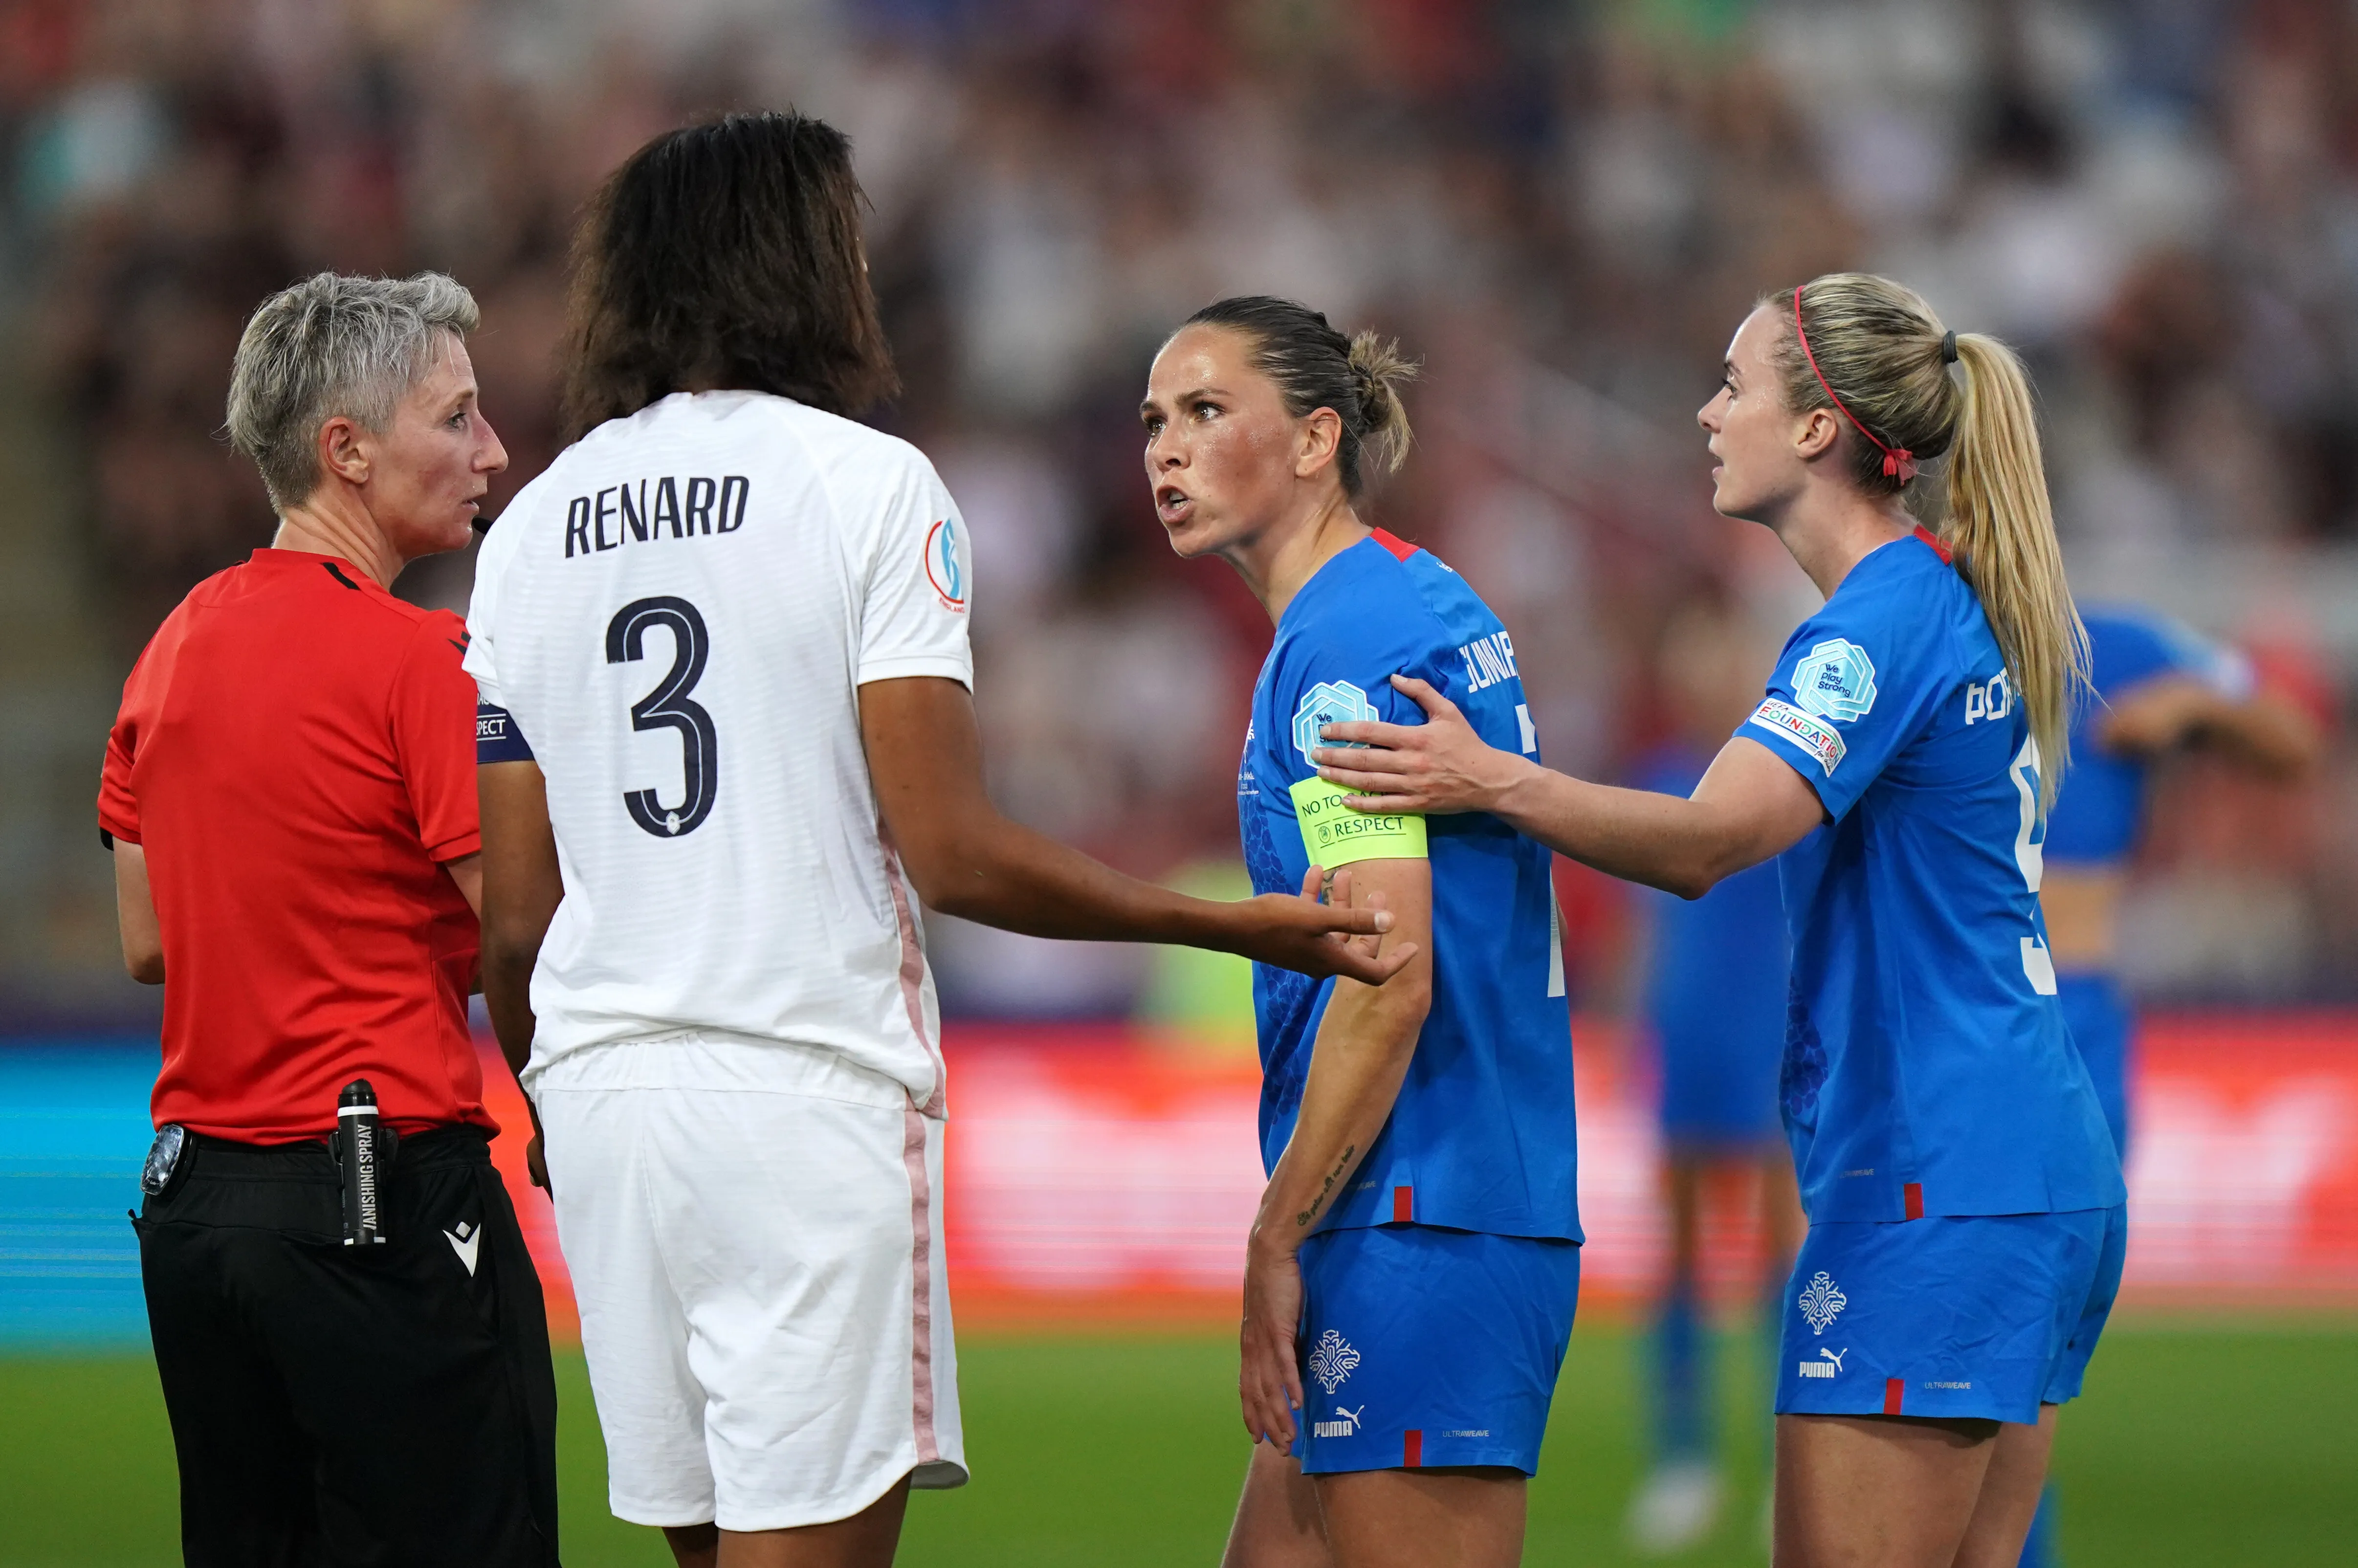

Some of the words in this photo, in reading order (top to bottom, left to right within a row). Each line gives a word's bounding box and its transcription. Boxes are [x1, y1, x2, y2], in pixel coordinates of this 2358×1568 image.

[565, 476, 749, 558] RENARD
[1826, 663, 1839, 672] We
[1821, 672, 1843, 685] Play
[1818, 681, 1851, 698] Strong
[1767, 701, 1789, 712] UEFA
[606, 596, 718, 838] 3
[1316, 713, 1332, 722] We
[1301, 801, 1321, 817] NO
[1322, 795, 1342, 809] TO
[1335, 817, 1404, 837] RESPECT
[357, 1124, 374, 1163] SPRAY
[1799, 1362, 1834, 1378] PUMA
[1924, 1381, 1971, 1390] ULTRAWEAVE
[1314, 1420, 1353, 1437] PUMA
[1442, 1430, 1490, 1438] ULTRAWEAVE
